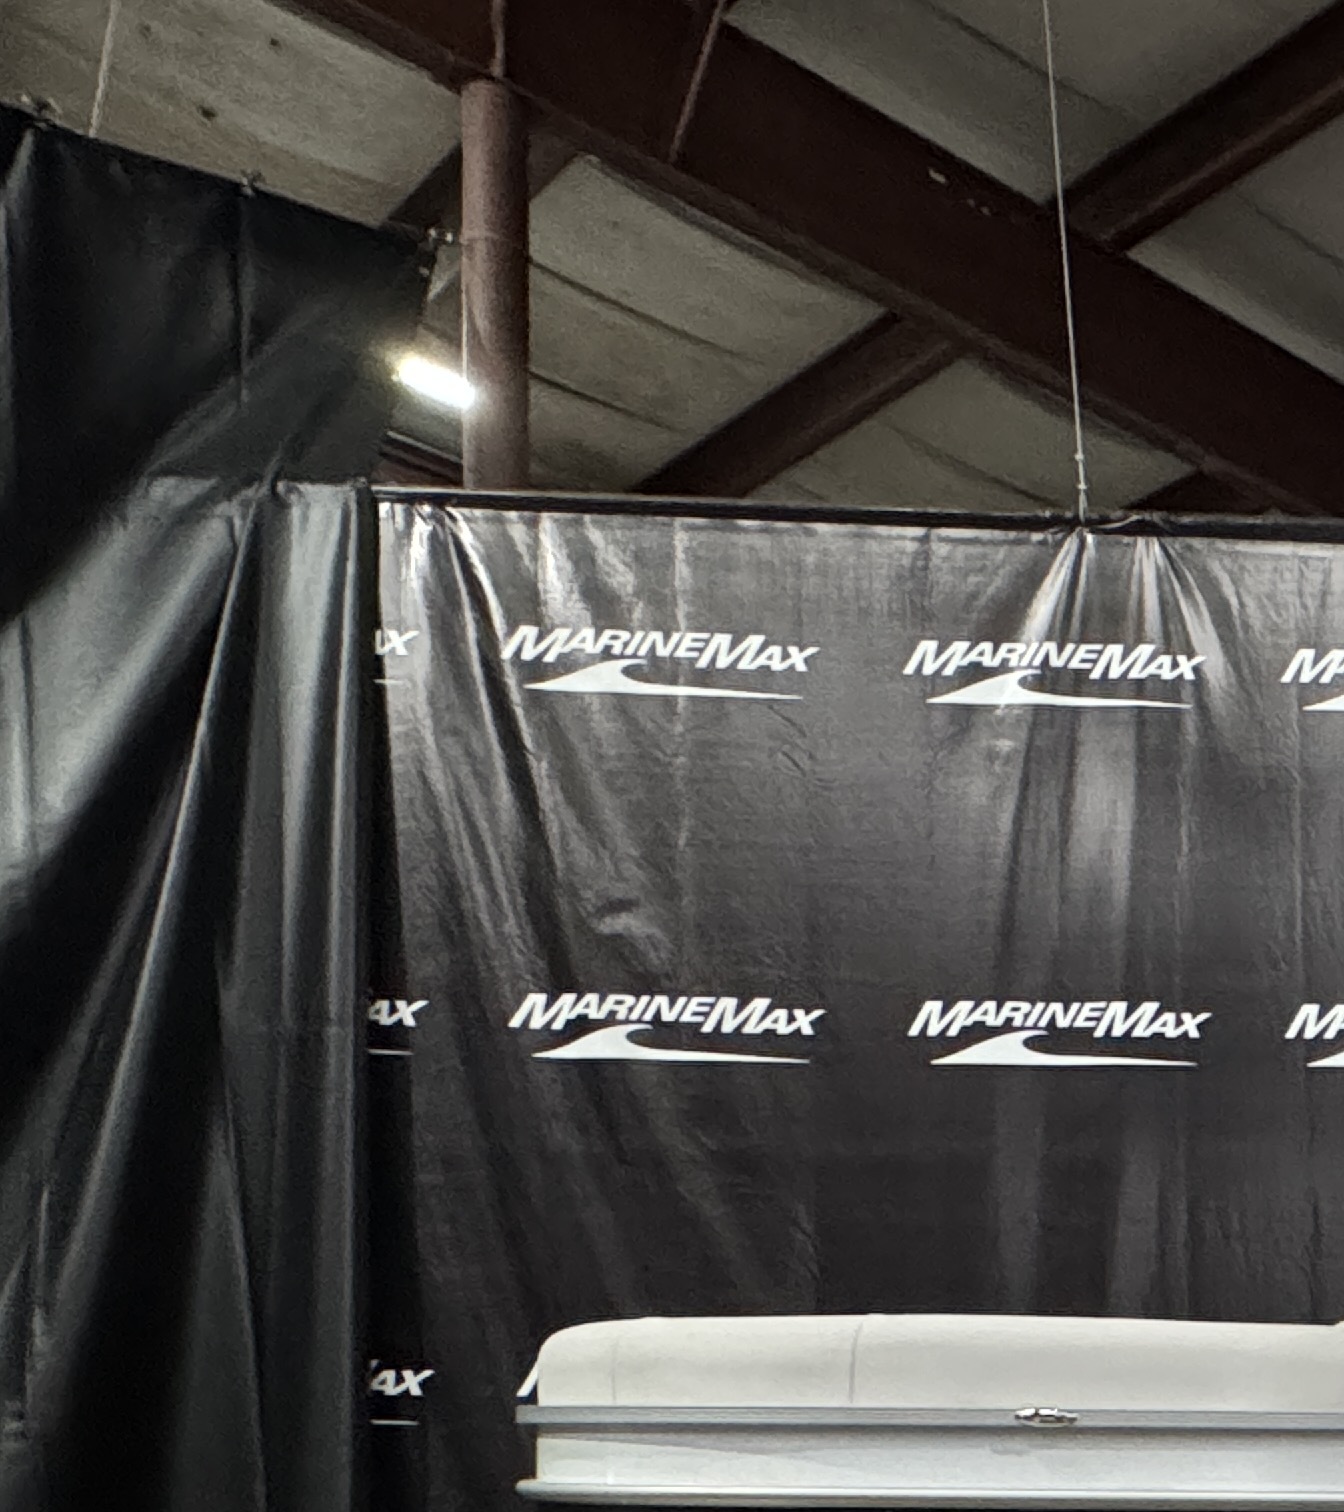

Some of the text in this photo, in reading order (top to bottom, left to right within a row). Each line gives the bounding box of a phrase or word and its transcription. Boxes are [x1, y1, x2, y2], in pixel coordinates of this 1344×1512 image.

[502, 626, 819, 673] MARINEMAX
[903, 640, 1206, 681] MARINEMAX
[509, 993, 827, 1036] MARINEMAX
[908, 1000, 1212, 1039] MARINEMAX
